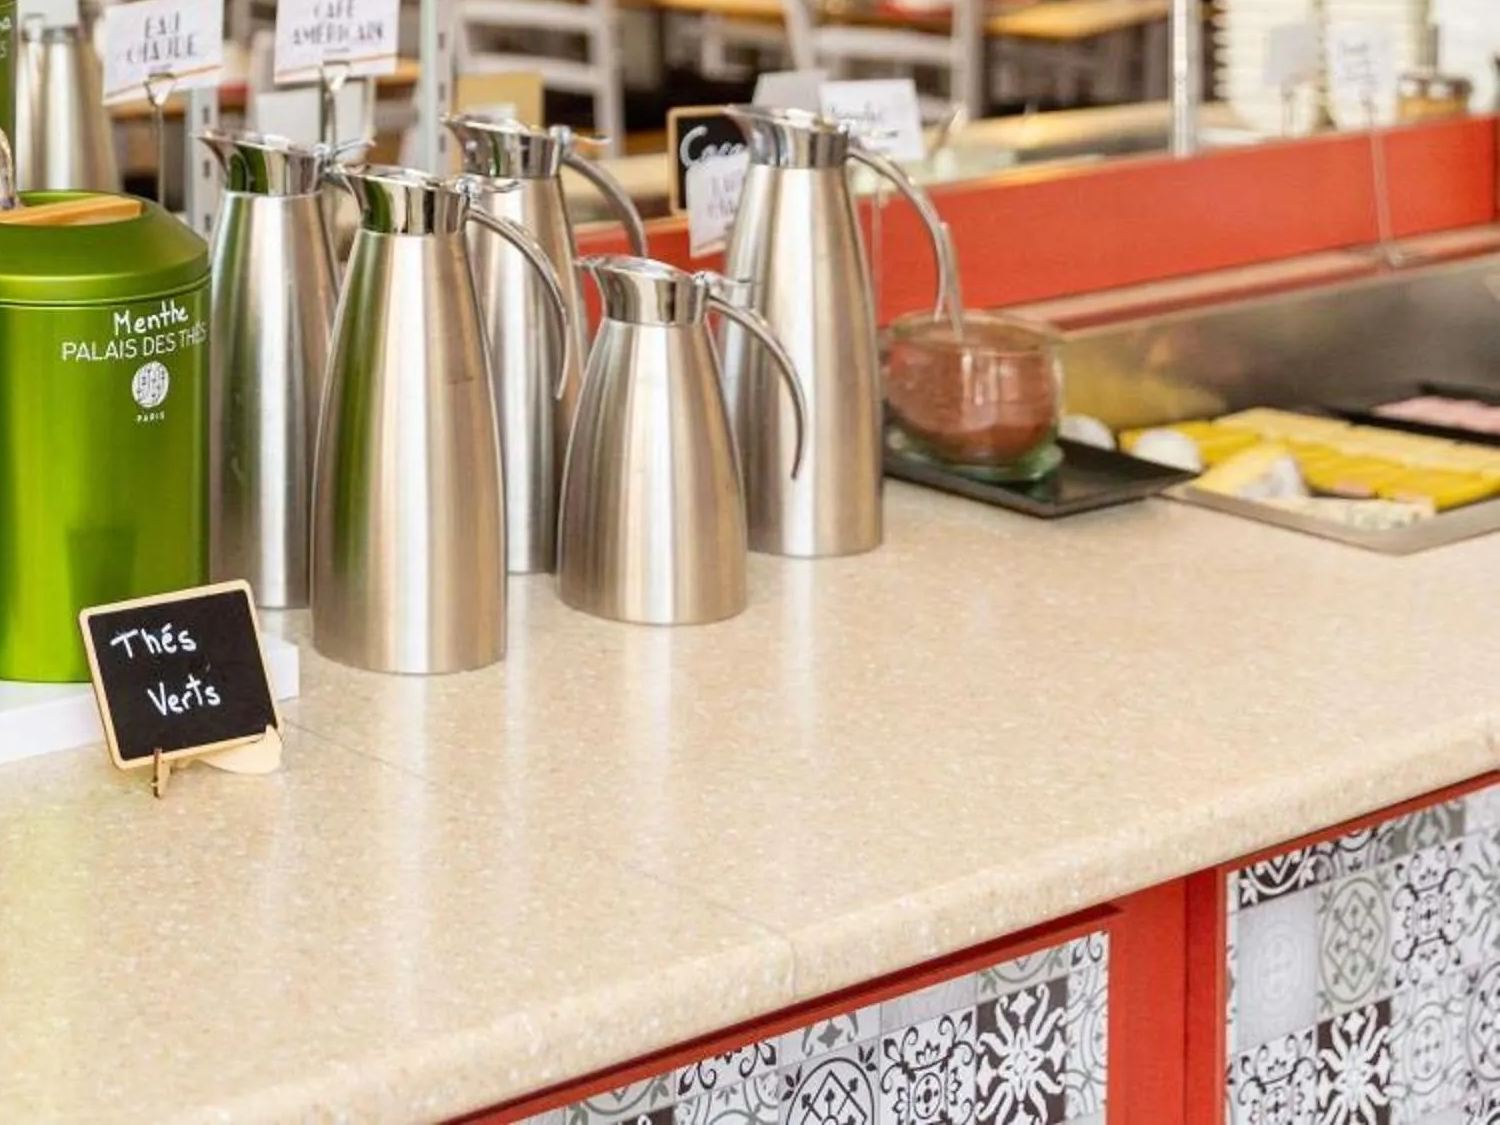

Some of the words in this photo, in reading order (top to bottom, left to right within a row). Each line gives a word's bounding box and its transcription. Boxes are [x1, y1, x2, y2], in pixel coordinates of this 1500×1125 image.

[113, 299, 189, 336] Menthe
[61, 338, 137, 362] PALAIS
[143, 332, 176, 356] DES
[109, 622, 197, 659] Thés
[146, 673, 222, 717] Verts
